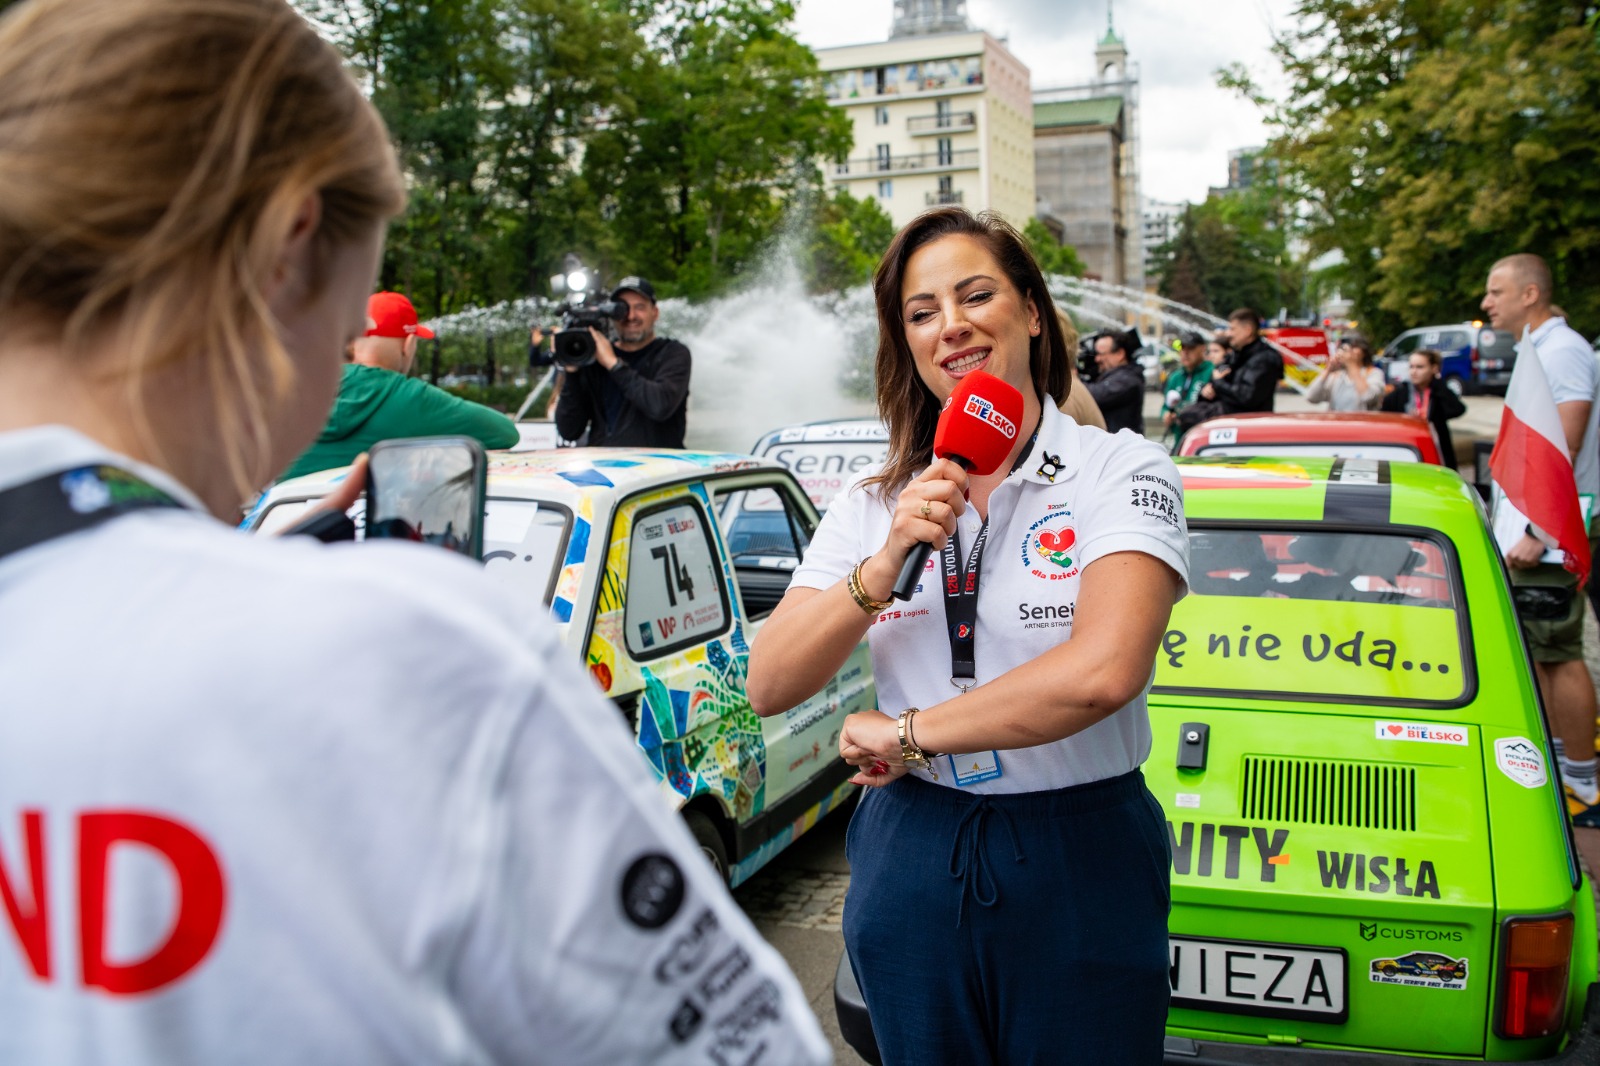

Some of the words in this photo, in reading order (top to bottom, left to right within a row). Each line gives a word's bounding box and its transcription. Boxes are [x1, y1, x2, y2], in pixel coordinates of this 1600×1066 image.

[971, 396, 992, 410] RADIO
[966, 401, 1014, 437] BIELSKO
[1213, 430, 1232, 439] 70
[1131, 488, 1174, 510] STARS
[1131, 497, 1178, 523] 4STARS
[1021, 533, 1031, 567] Wielka
[1029, 510, 1071, 531] Wyprawa
[650, 543, 695, 608] 74
[1031, 569, 1047, 579] dla
[1049, 567, 1079, 581] Dzieci
[879, 610, 902, 622] STS
[903, 608, 930, 618] Logistic
[1208, 625, 1281, 661] nie
[1381, 728, 1385, 737] I
[1407, 730, 1463, 742] BIELSKO
[1316, 850, 1441, 899] WISŁA
[1380, 927, 1463, 942] CUSTOMS
